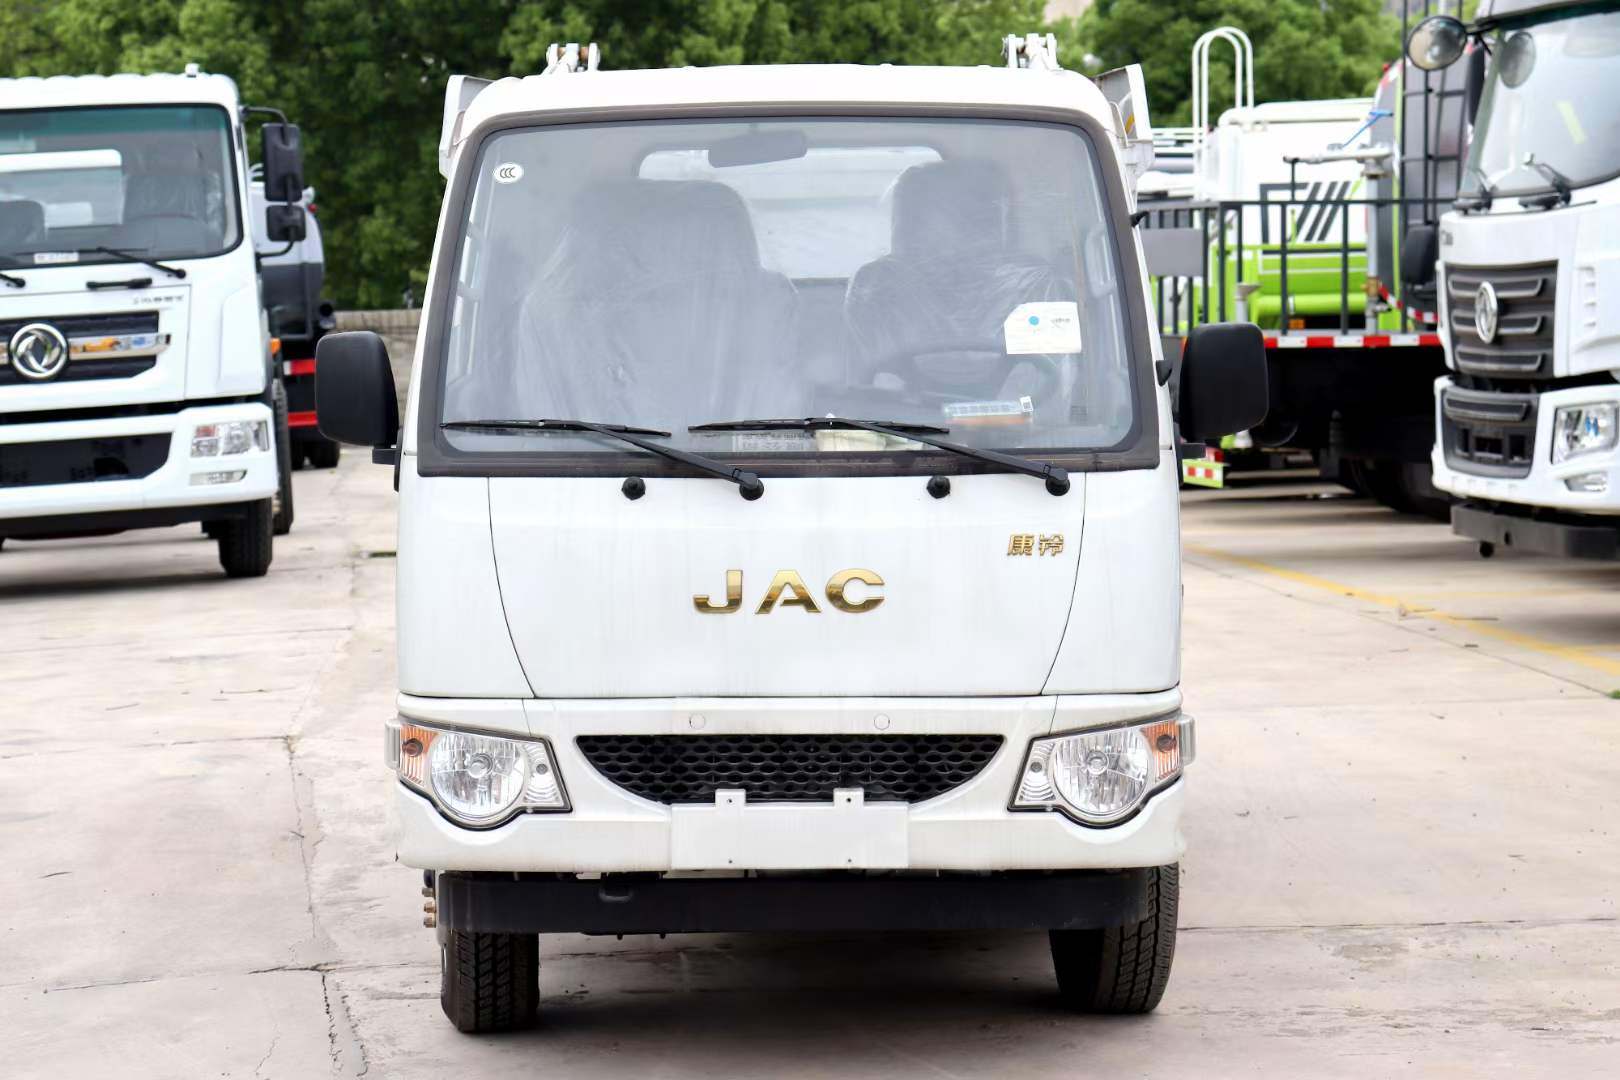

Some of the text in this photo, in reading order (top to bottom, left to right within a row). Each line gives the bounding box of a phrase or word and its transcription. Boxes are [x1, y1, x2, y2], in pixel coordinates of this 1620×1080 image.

[499, 166, 516, 179] CCC
[1007, 533, 1064, 556] 康铃
[693, 568, 885, 615] JAC
